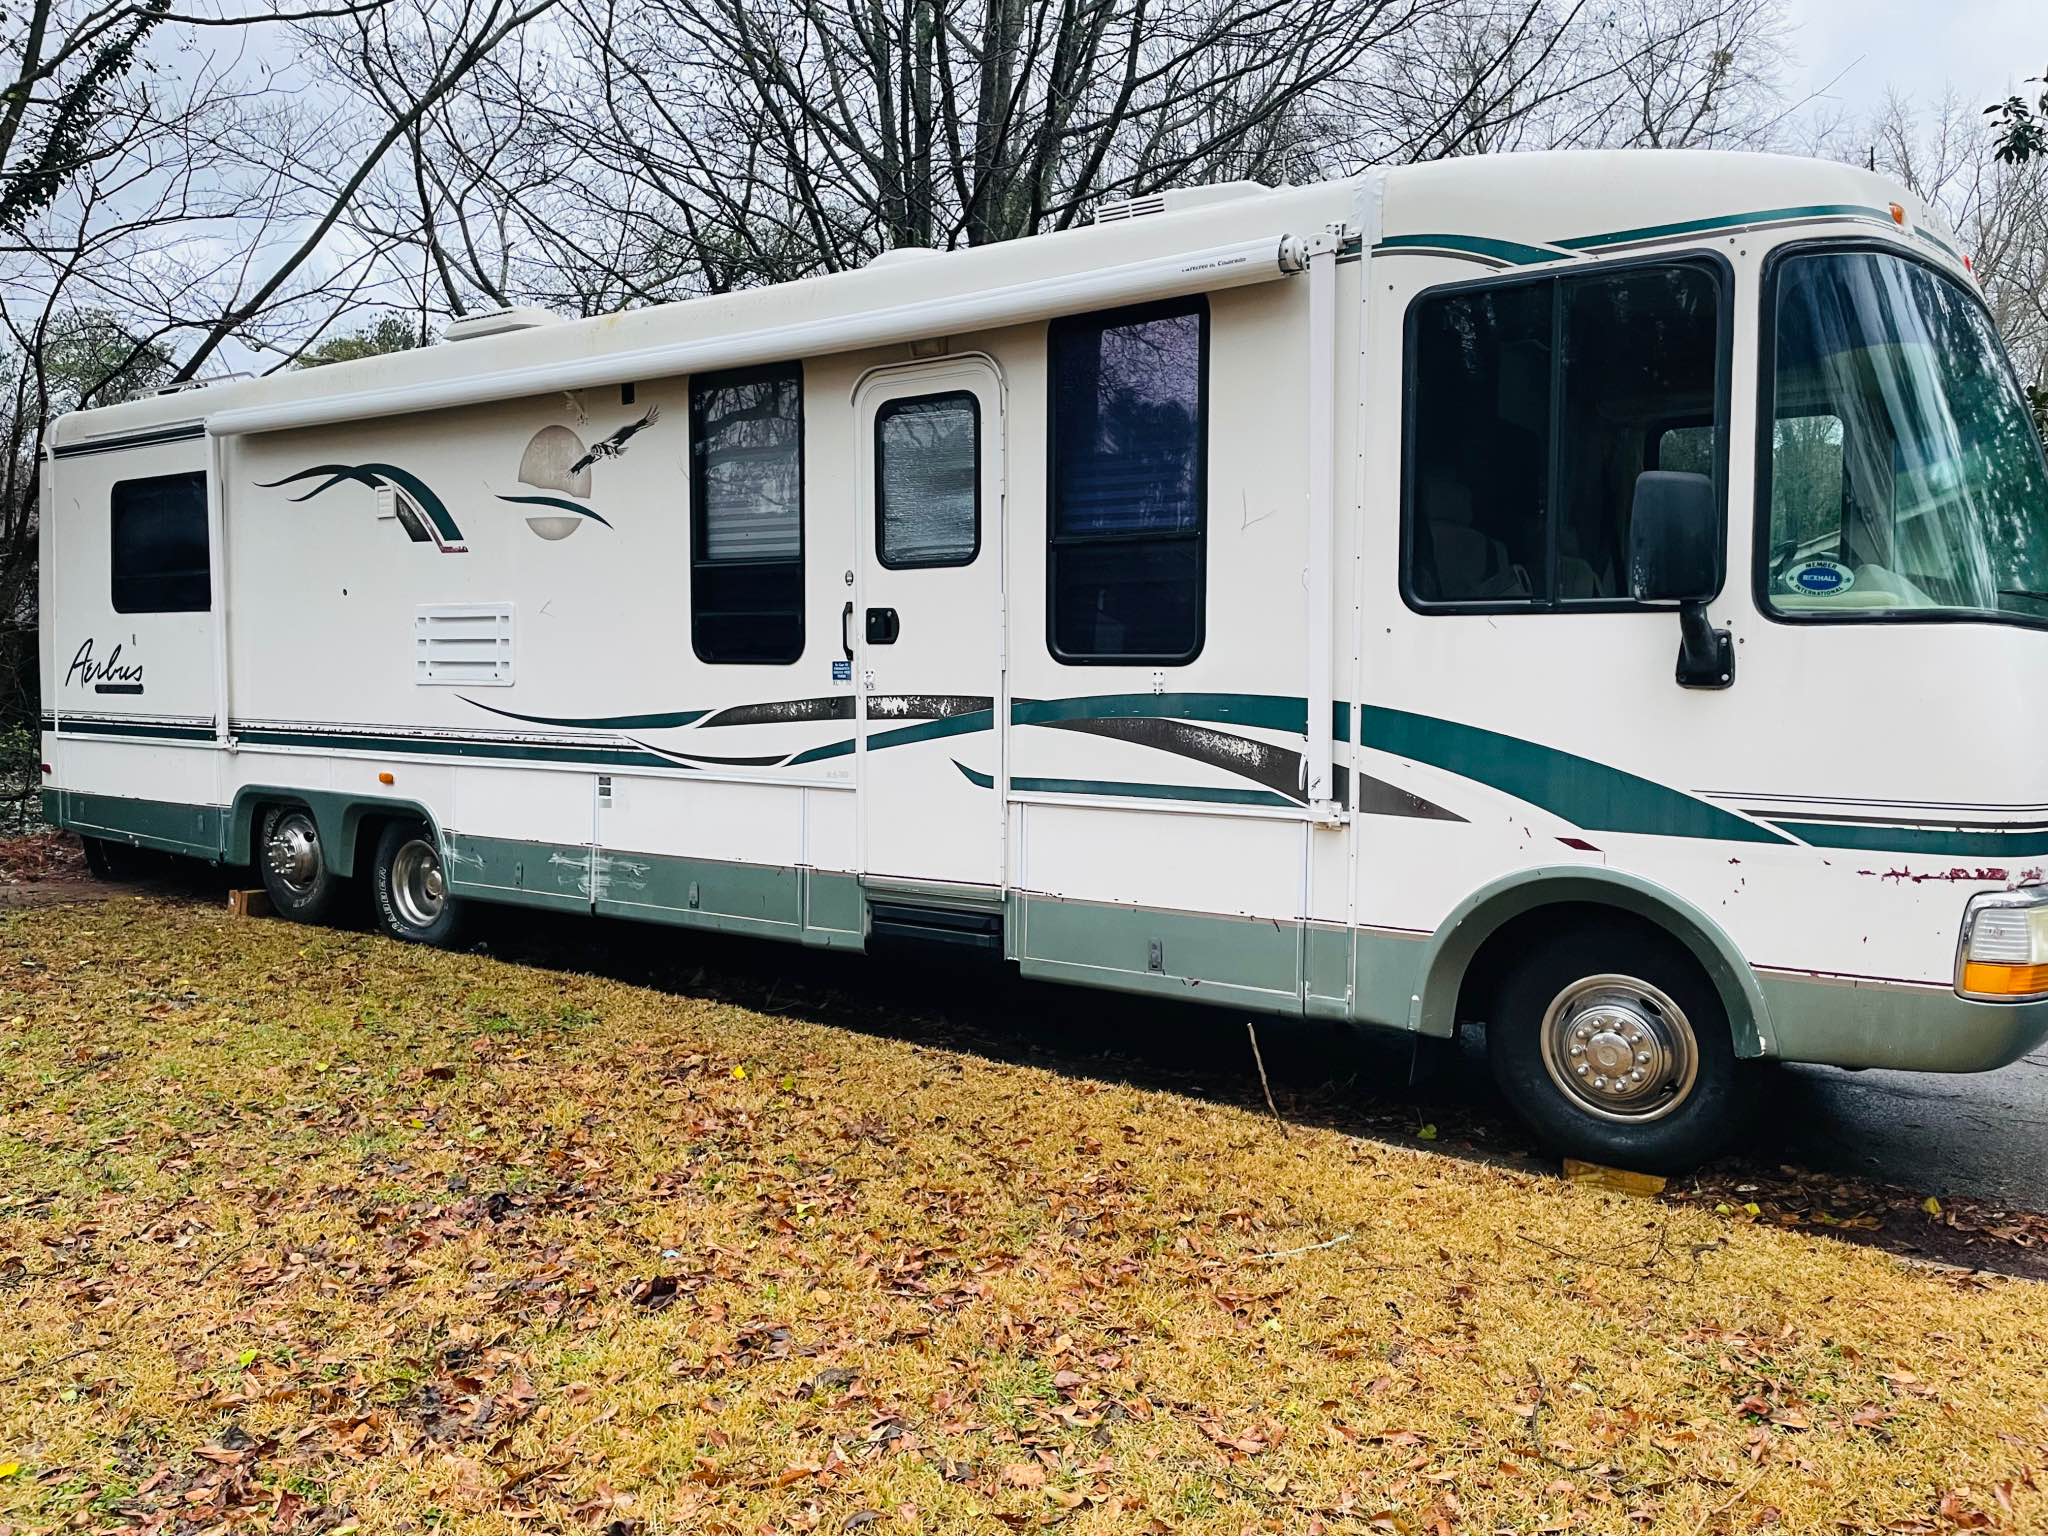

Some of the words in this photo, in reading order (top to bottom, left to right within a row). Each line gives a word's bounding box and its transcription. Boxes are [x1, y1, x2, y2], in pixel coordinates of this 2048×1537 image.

[1805, 561, 1838, 570] MEMBER
[1794, 583, 1844, 596] INTERNATIONAL
[65, 638, 143, 688] Aerbus
